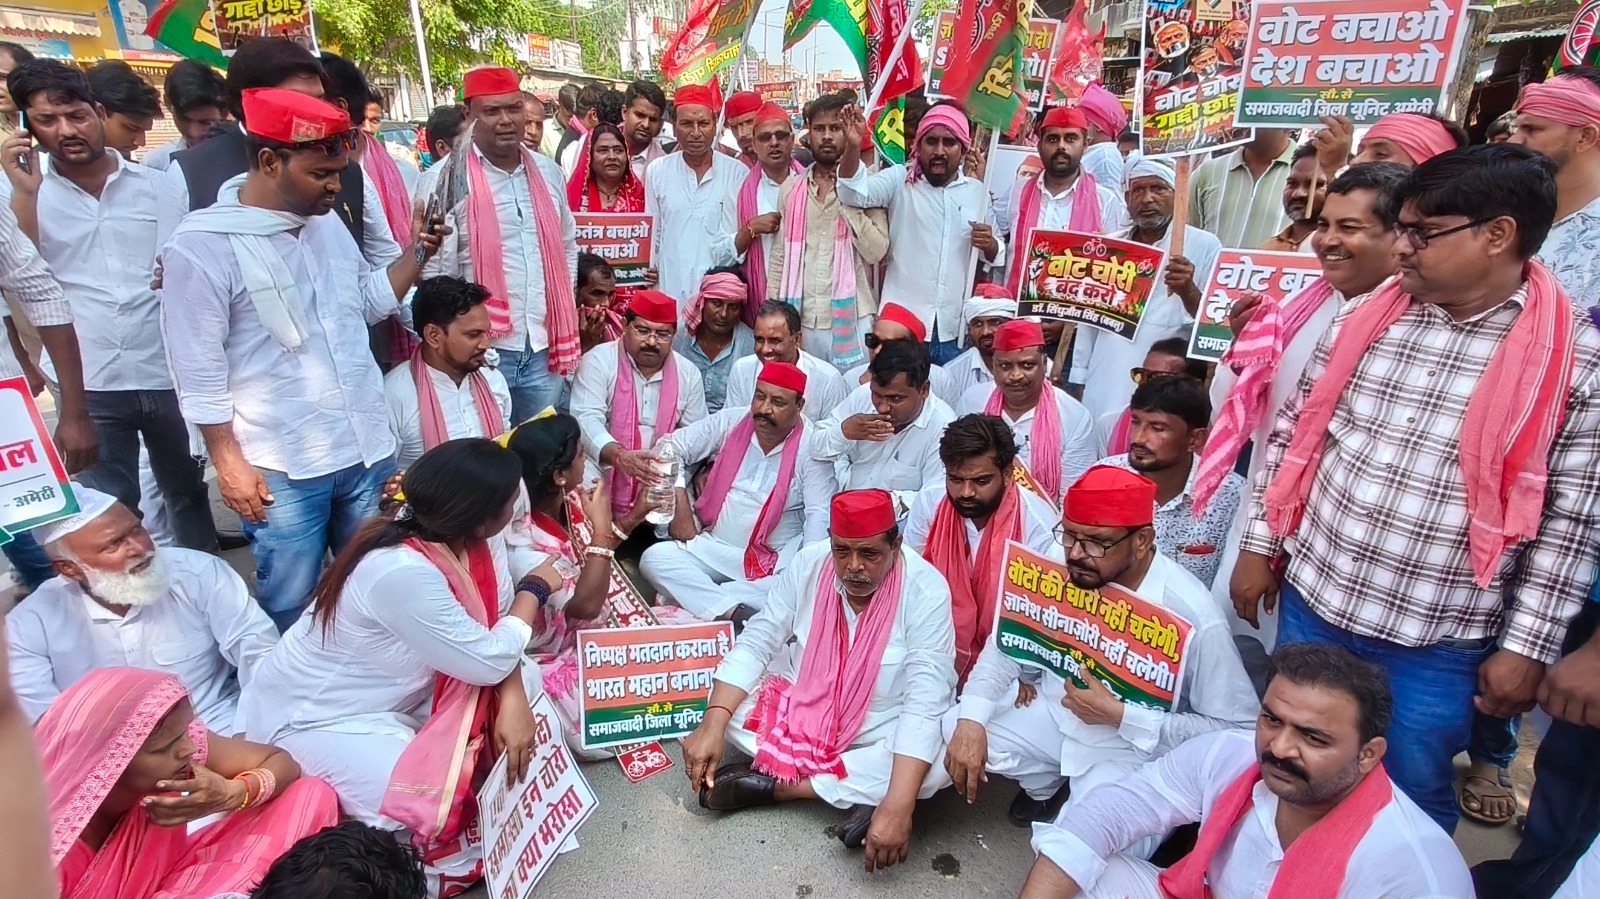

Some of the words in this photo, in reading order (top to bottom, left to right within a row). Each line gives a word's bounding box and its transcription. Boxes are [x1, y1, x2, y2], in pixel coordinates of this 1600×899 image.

[1258, 5, 1327, 46] वोट
[1330, 2, 1454, 44] बचाओ
[1250, 48, 1311, 87] देश
[1314, 43, 1444, 85] बचाओ
[1155, 86, 1198, 110] वोट
[1156, 102, 1199, 128] गद्दी
[1245, 98, 1313, 117] समाजवादी
[1313, 99, 1348, 117] जिला
[1350, 98, 1391, 120] यूनिट
[605, 220, 650, 239] बचाओ
[1047, 248, 1091, 279] वोट
[1092, 255, 1136, 293] चोरी
[1216, 255, 1277, 291] वोट
[1083, 285, 1117, 306] करो
[1007, 555, 1042, 593] वोटों
[1040, 569, 1066, 602] की
[1099, 598, 1133, 632] नहीं
[1130, 615, 1180, 663] चलेगी,
[1003, 591, 1042, 622] ज्ञानेश
[1099, 635, 1129, 666] नहीं
[585, 642, 628, 669] निष्पक्ष
[628, 642, 674, 665] मतदान
[675, 637, 717, 660] कराना
[715, 630, 731, 657] है
[1001, 632, 1061, 668] समाजवादी
[587, 677, 626, 701] भारत
[628, 672, 669, 698] महान
[589, 715, 643, 737] समाजवादी
[644, 714, 672, 730] जिला
[674, 708, 704, 728] यूनिट
[520, 776, 543, 820] इन
[515, 832, 544, 884] क्या
[538, 784, 584, 847] भरोसा
